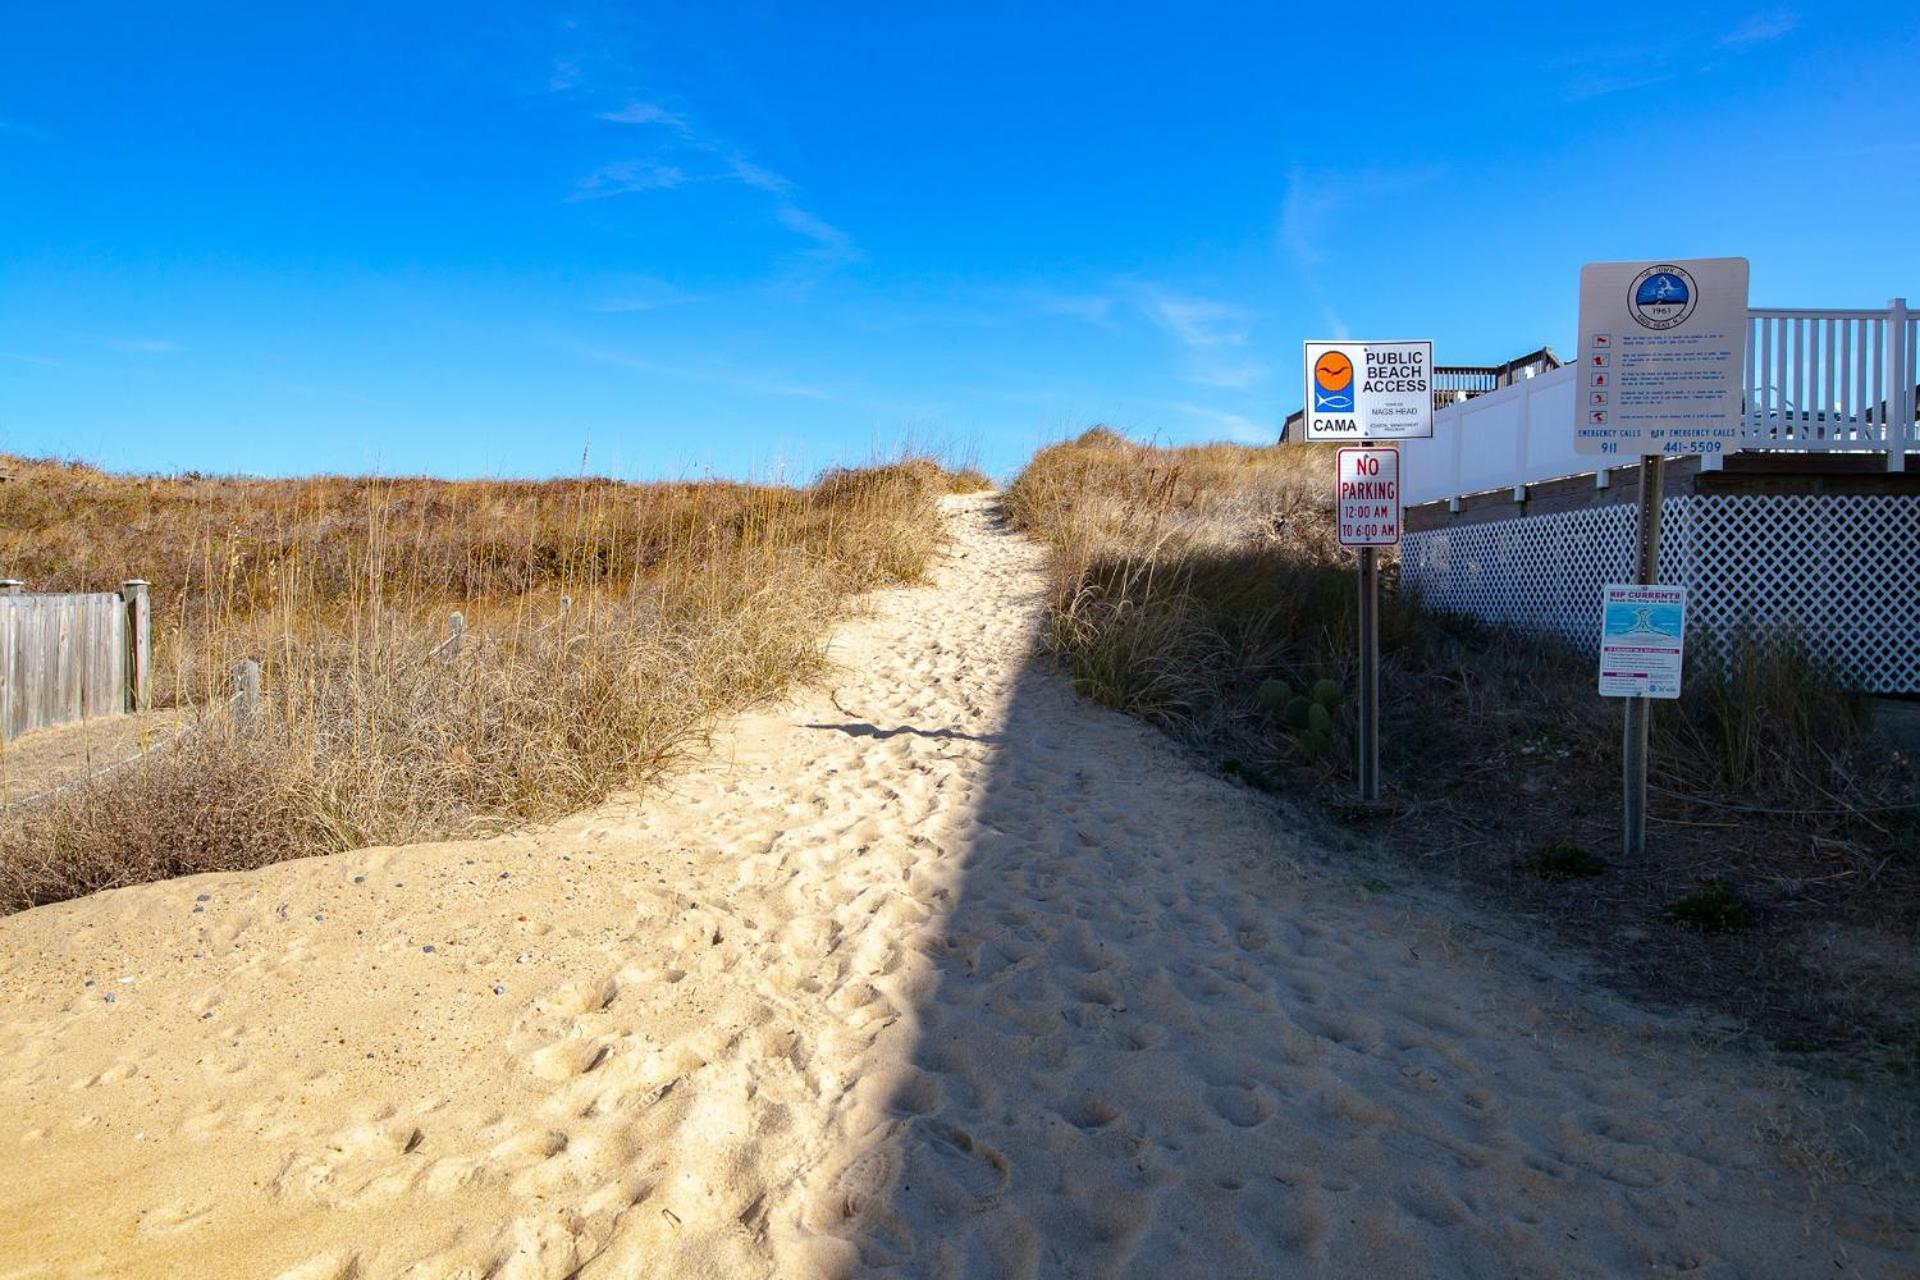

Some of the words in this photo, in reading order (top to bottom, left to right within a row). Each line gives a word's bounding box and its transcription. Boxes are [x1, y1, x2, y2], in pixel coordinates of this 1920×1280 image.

[1652, 307, 1671, 315] 1961
[1366, 351, 1423, 365] PUBLIC
[1367, 365, 1422, 379] BEACH
[1363, 379, 1427, 393] ACCESS
[1371, 407, 1394, 416] NAGS
[1395, 407, 1418, 416] HEAD
[1313, 419, 1358, 432] CAMA
[1578, 429, 1617, 438] EMERGENCY
[1619, 429, 1641, 438] CALLS
[1713, 428, 1736, 437] CALLS
[1601, 442, 1617, 454] 911
[1663, 441, 1722, 453] 441-5509
[1357, 458, 1379, 476] NO
[1342, 482, 1395, 500] PARKING
[1345, 506, 1370, 518] 12:00
[1374, 506, 1388, 518] AM
[1342, 524, 1352, 536] TO
[1356, 524, 1378, 536] 6:00
[1381, 524, 1395, 536] AM
[1628, 591, 1681, 600] CURRENTS
